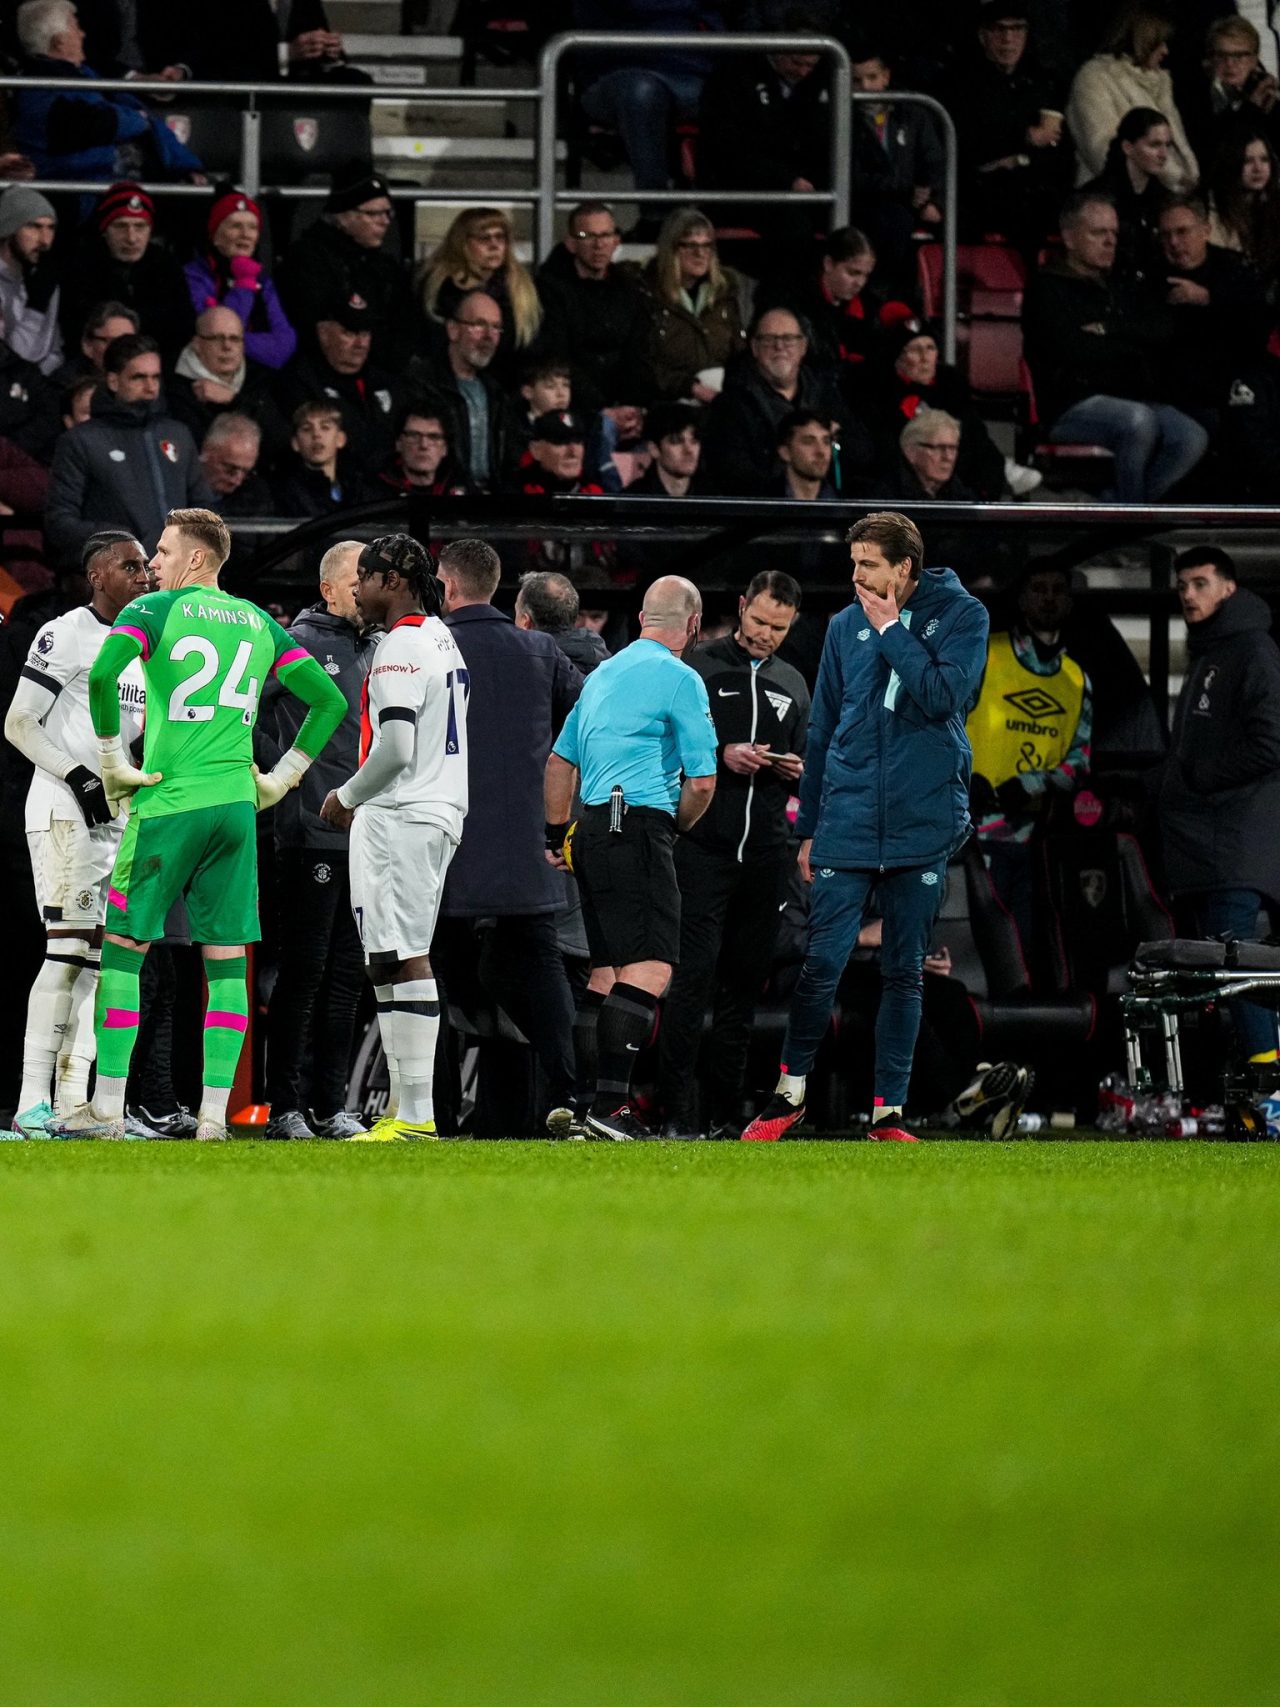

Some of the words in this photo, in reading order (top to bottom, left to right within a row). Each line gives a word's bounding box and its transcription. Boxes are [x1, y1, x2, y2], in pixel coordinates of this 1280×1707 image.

[182, 603, 263, 632] KAMINSKI
[167, 634, 258, 726] 24
[1006, 718, 1058, 738] umbro
